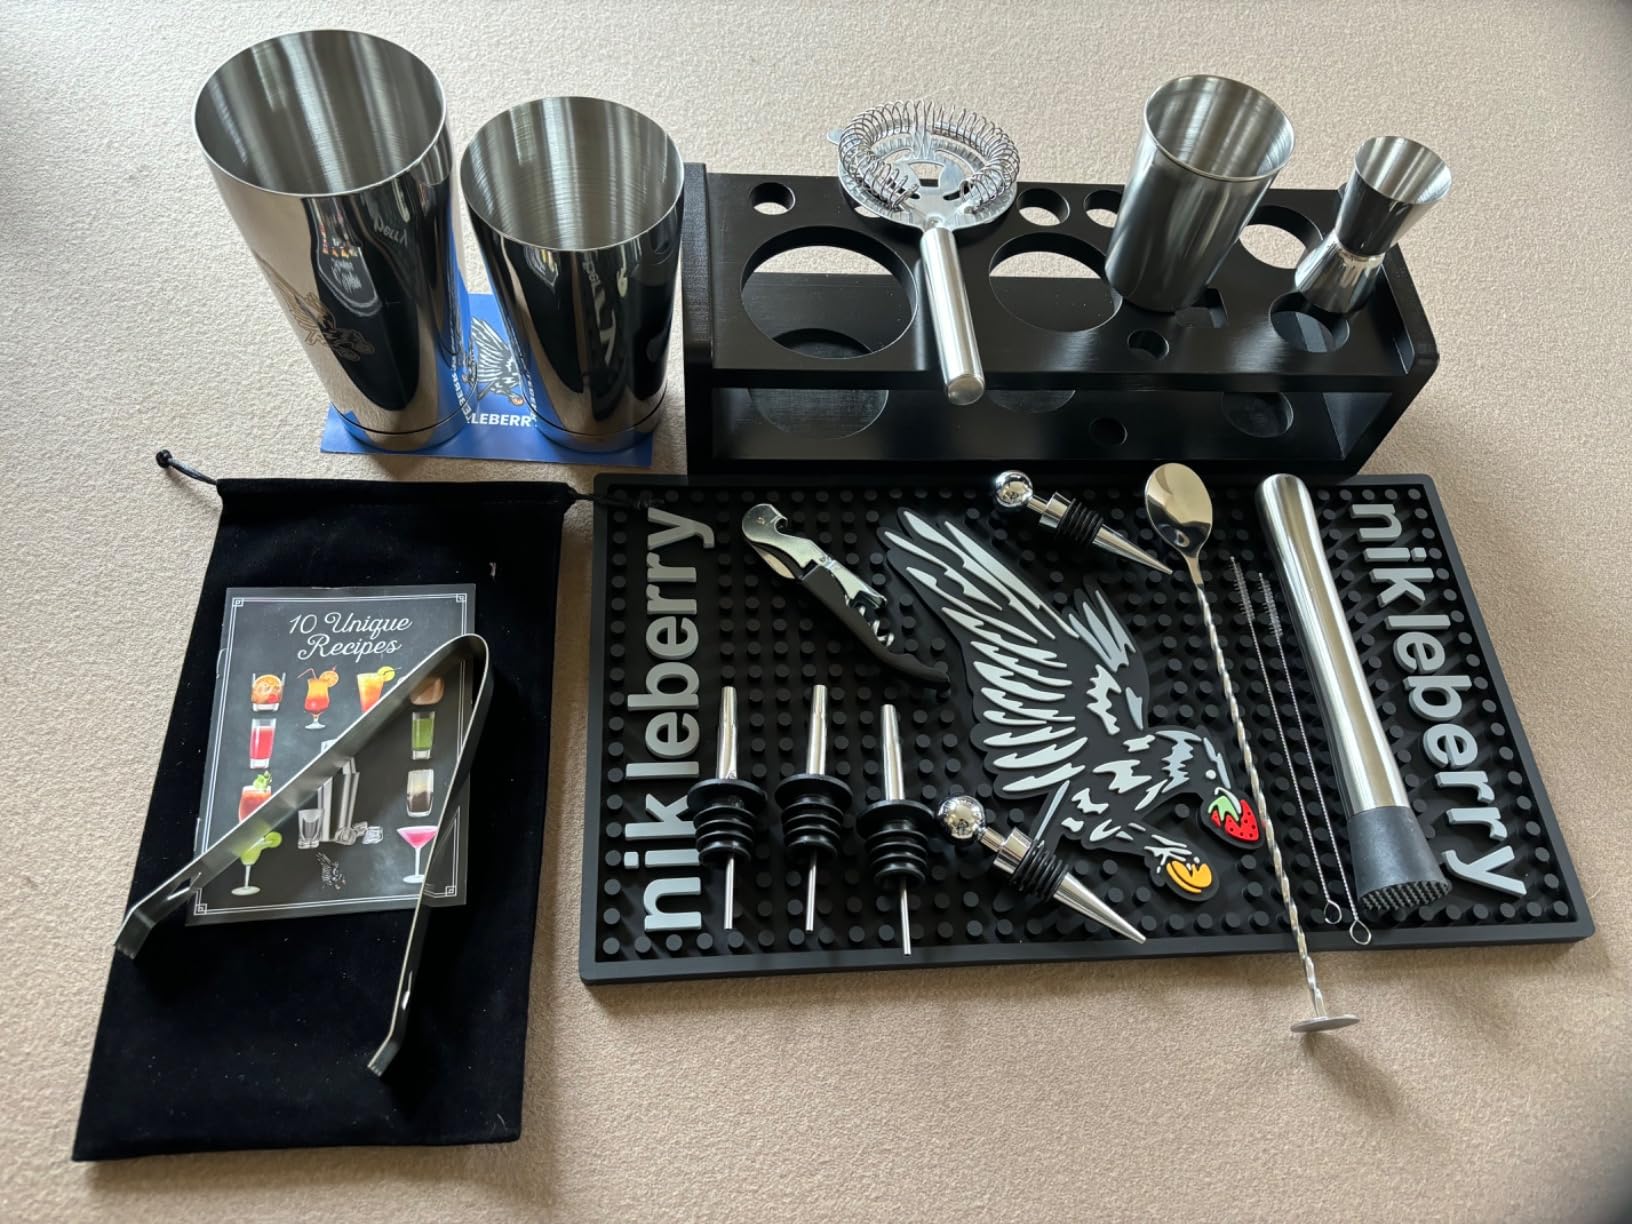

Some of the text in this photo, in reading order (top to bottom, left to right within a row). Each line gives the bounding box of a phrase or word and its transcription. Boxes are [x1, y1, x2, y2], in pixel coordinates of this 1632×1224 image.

[469, 412, 533, 427] LEBERR
[289, 612, 413, 639] 10 Unique
[298, 634, 402, 663] Recipes
[1351, 504, 1527, 896] nikleberry
[624, 507, 715, 932] nikleberry
